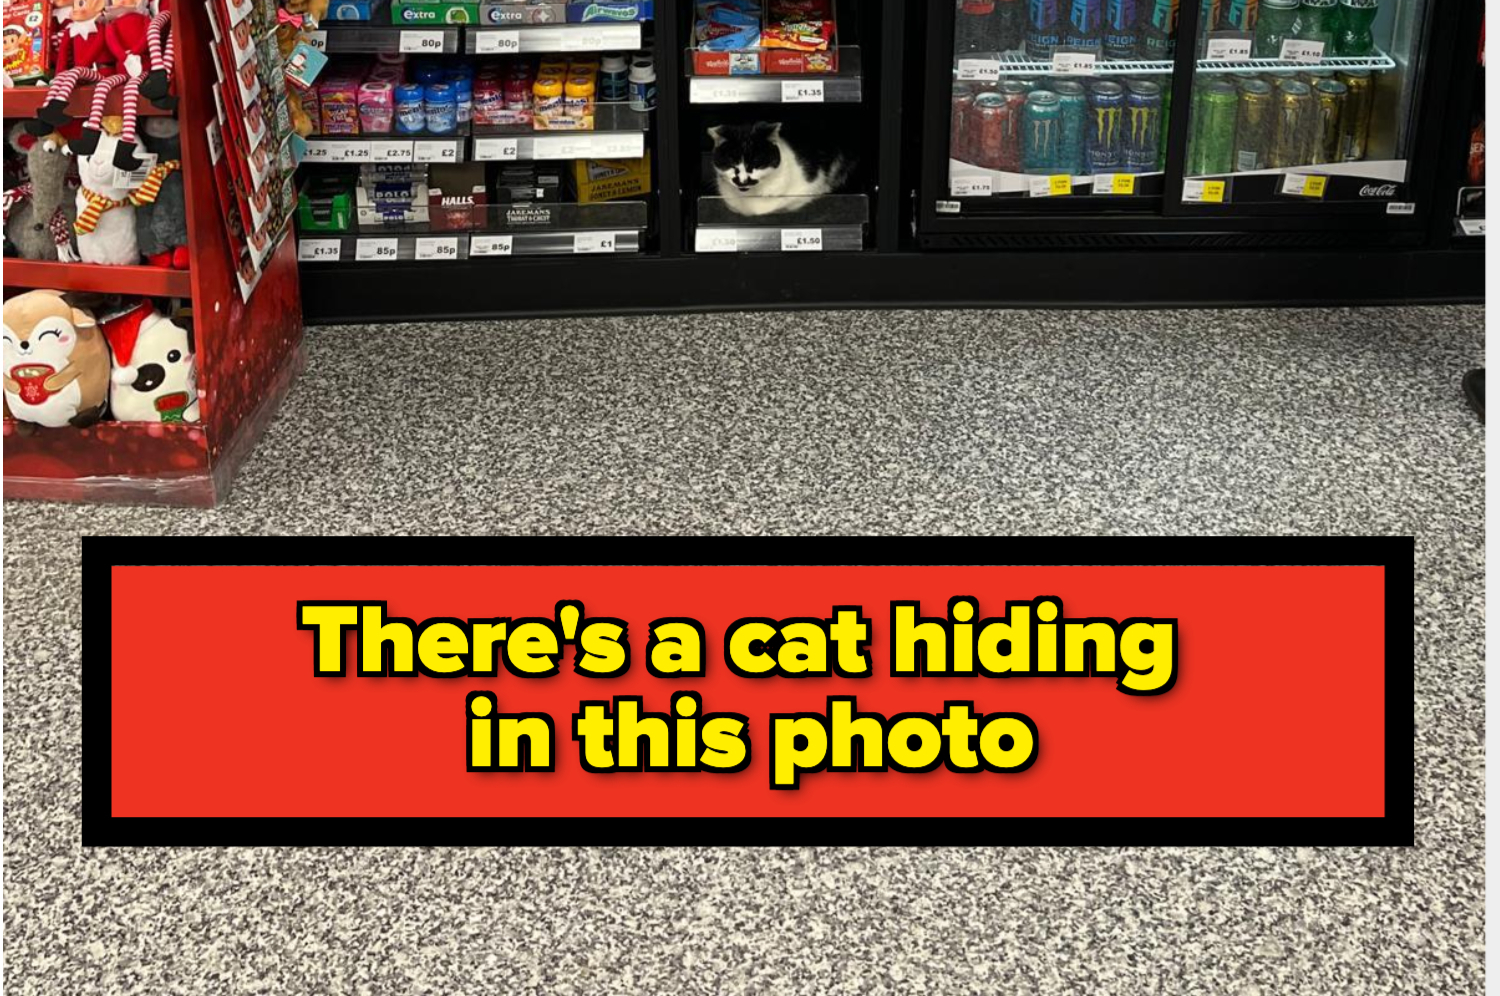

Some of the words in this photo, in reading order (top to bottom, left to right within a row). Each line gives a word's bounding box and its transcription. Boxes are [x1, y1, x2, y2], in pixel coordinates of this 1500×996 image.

[403, 9, 436, 20] extra
[490, 7, 522, 20] extra
[421, 39, 441, 49] 80p
[498, 39, 517, 48] 80p
[797, 88, 822, 97] £1.35
[442, 149, 454, 157] £2
[503, 147, 516, 155] £2
[591, 178, 639, 193] JAKEMANS
[1359, 184, 1397, 197] Coca-Cola
[441, 196, 475, 206] HALLS
[601, 240, 612, 248] £1
[797, 237, 821, 245] £1.50
[314, 247, 339, 255] £1.35
[377, 247, 396, 256] 85p
[436, 246, 456, 255] 85p
[491, 243, 510, 252] 85p
